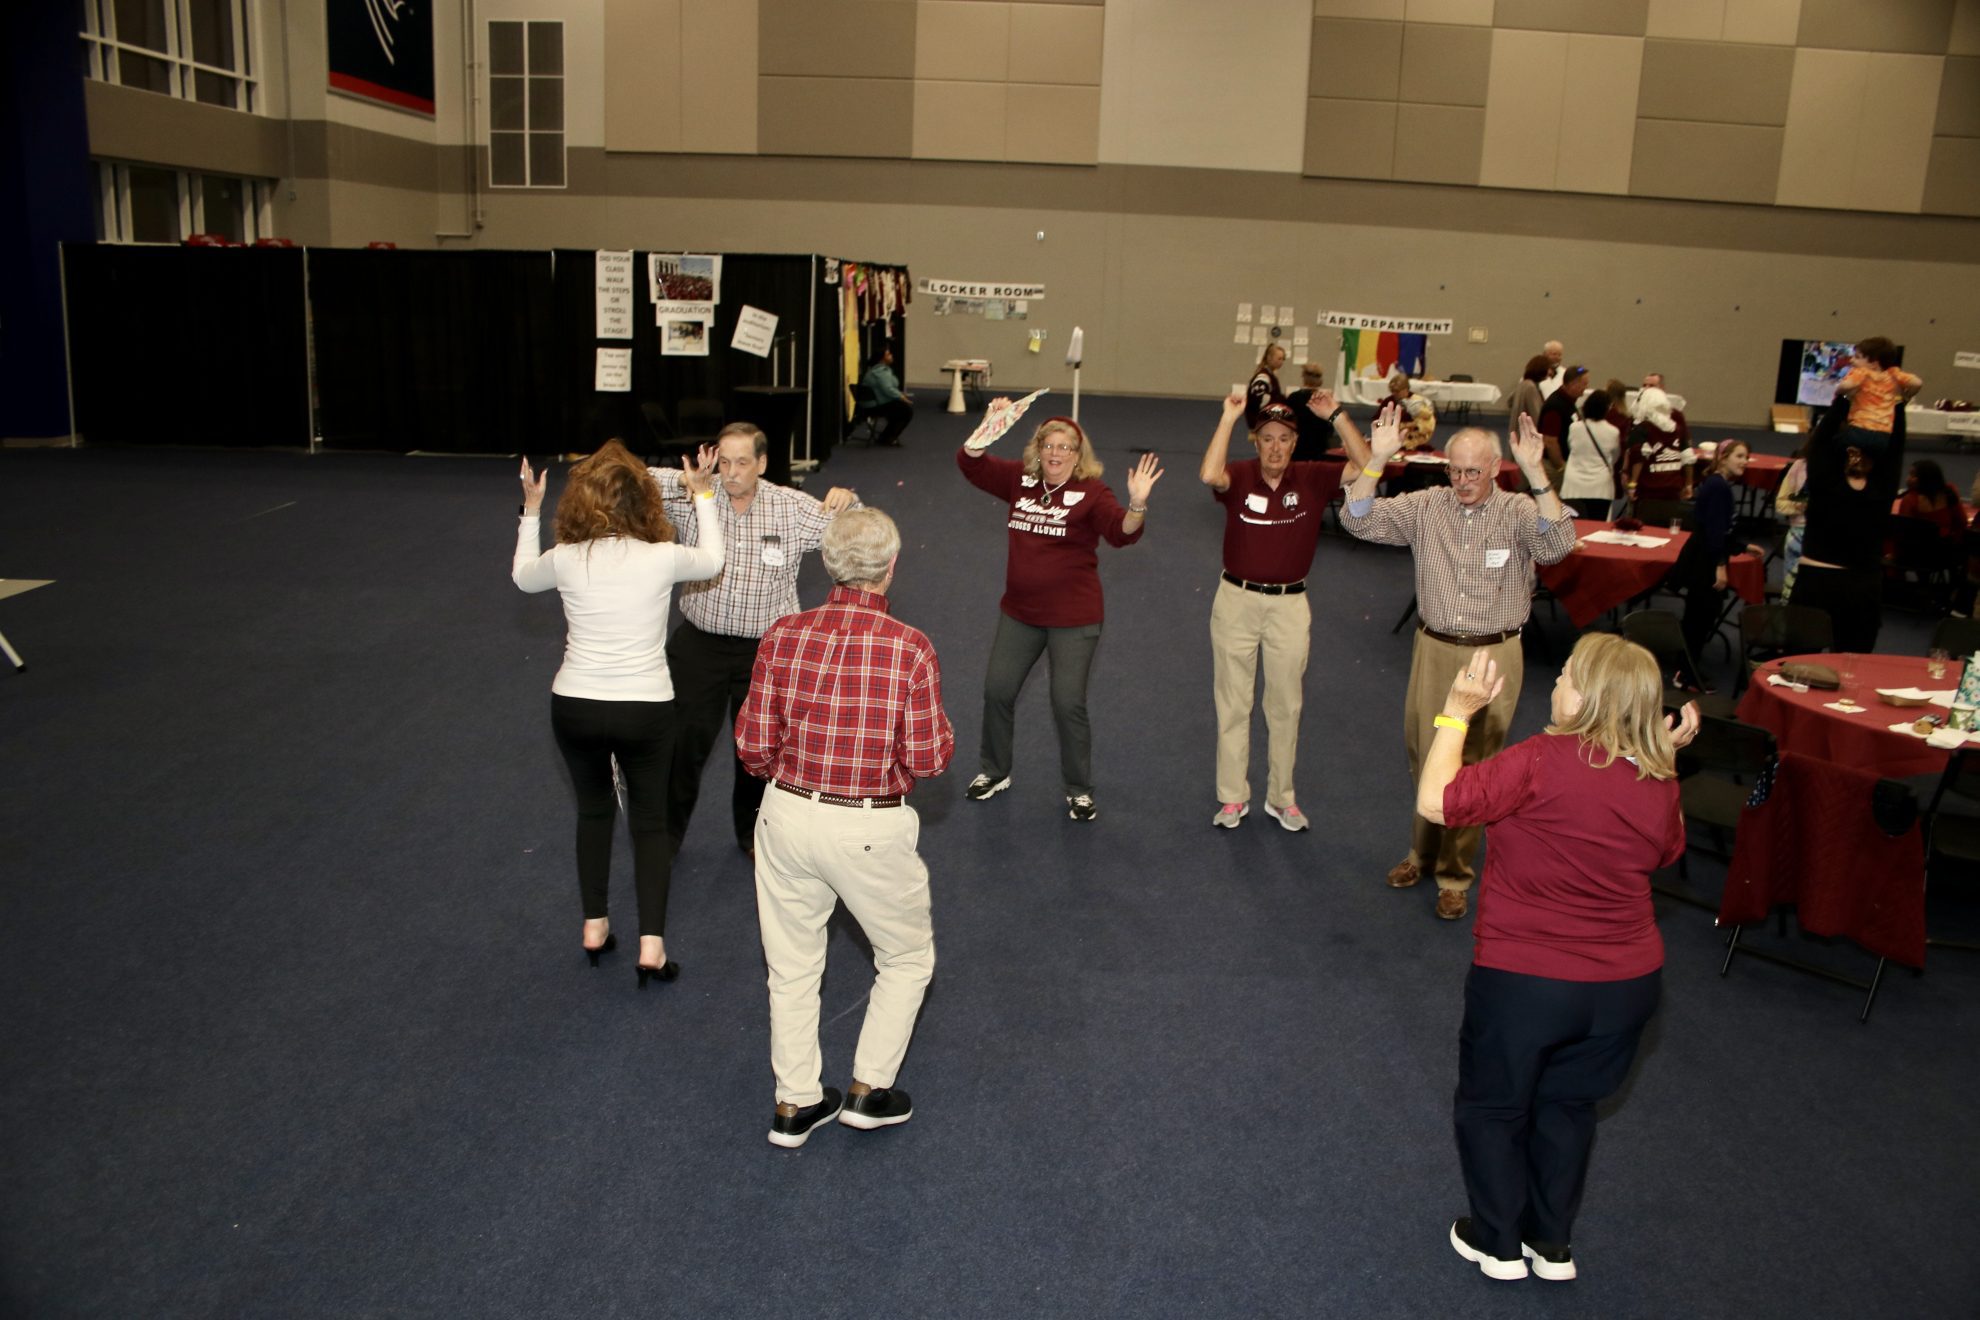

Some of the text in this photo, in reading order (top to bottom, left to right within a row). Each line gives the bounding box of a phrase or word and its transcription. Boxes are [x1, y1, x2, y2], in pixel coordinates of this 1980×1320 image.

[930, 283, 1033, 297] LOCKER ROOM
[659, 306, 711, 314] GRADUATION
[1328, 315, 1451, 332] ART DEPARTMENT
[1033, 524, 1066, 536] ALUMNI
